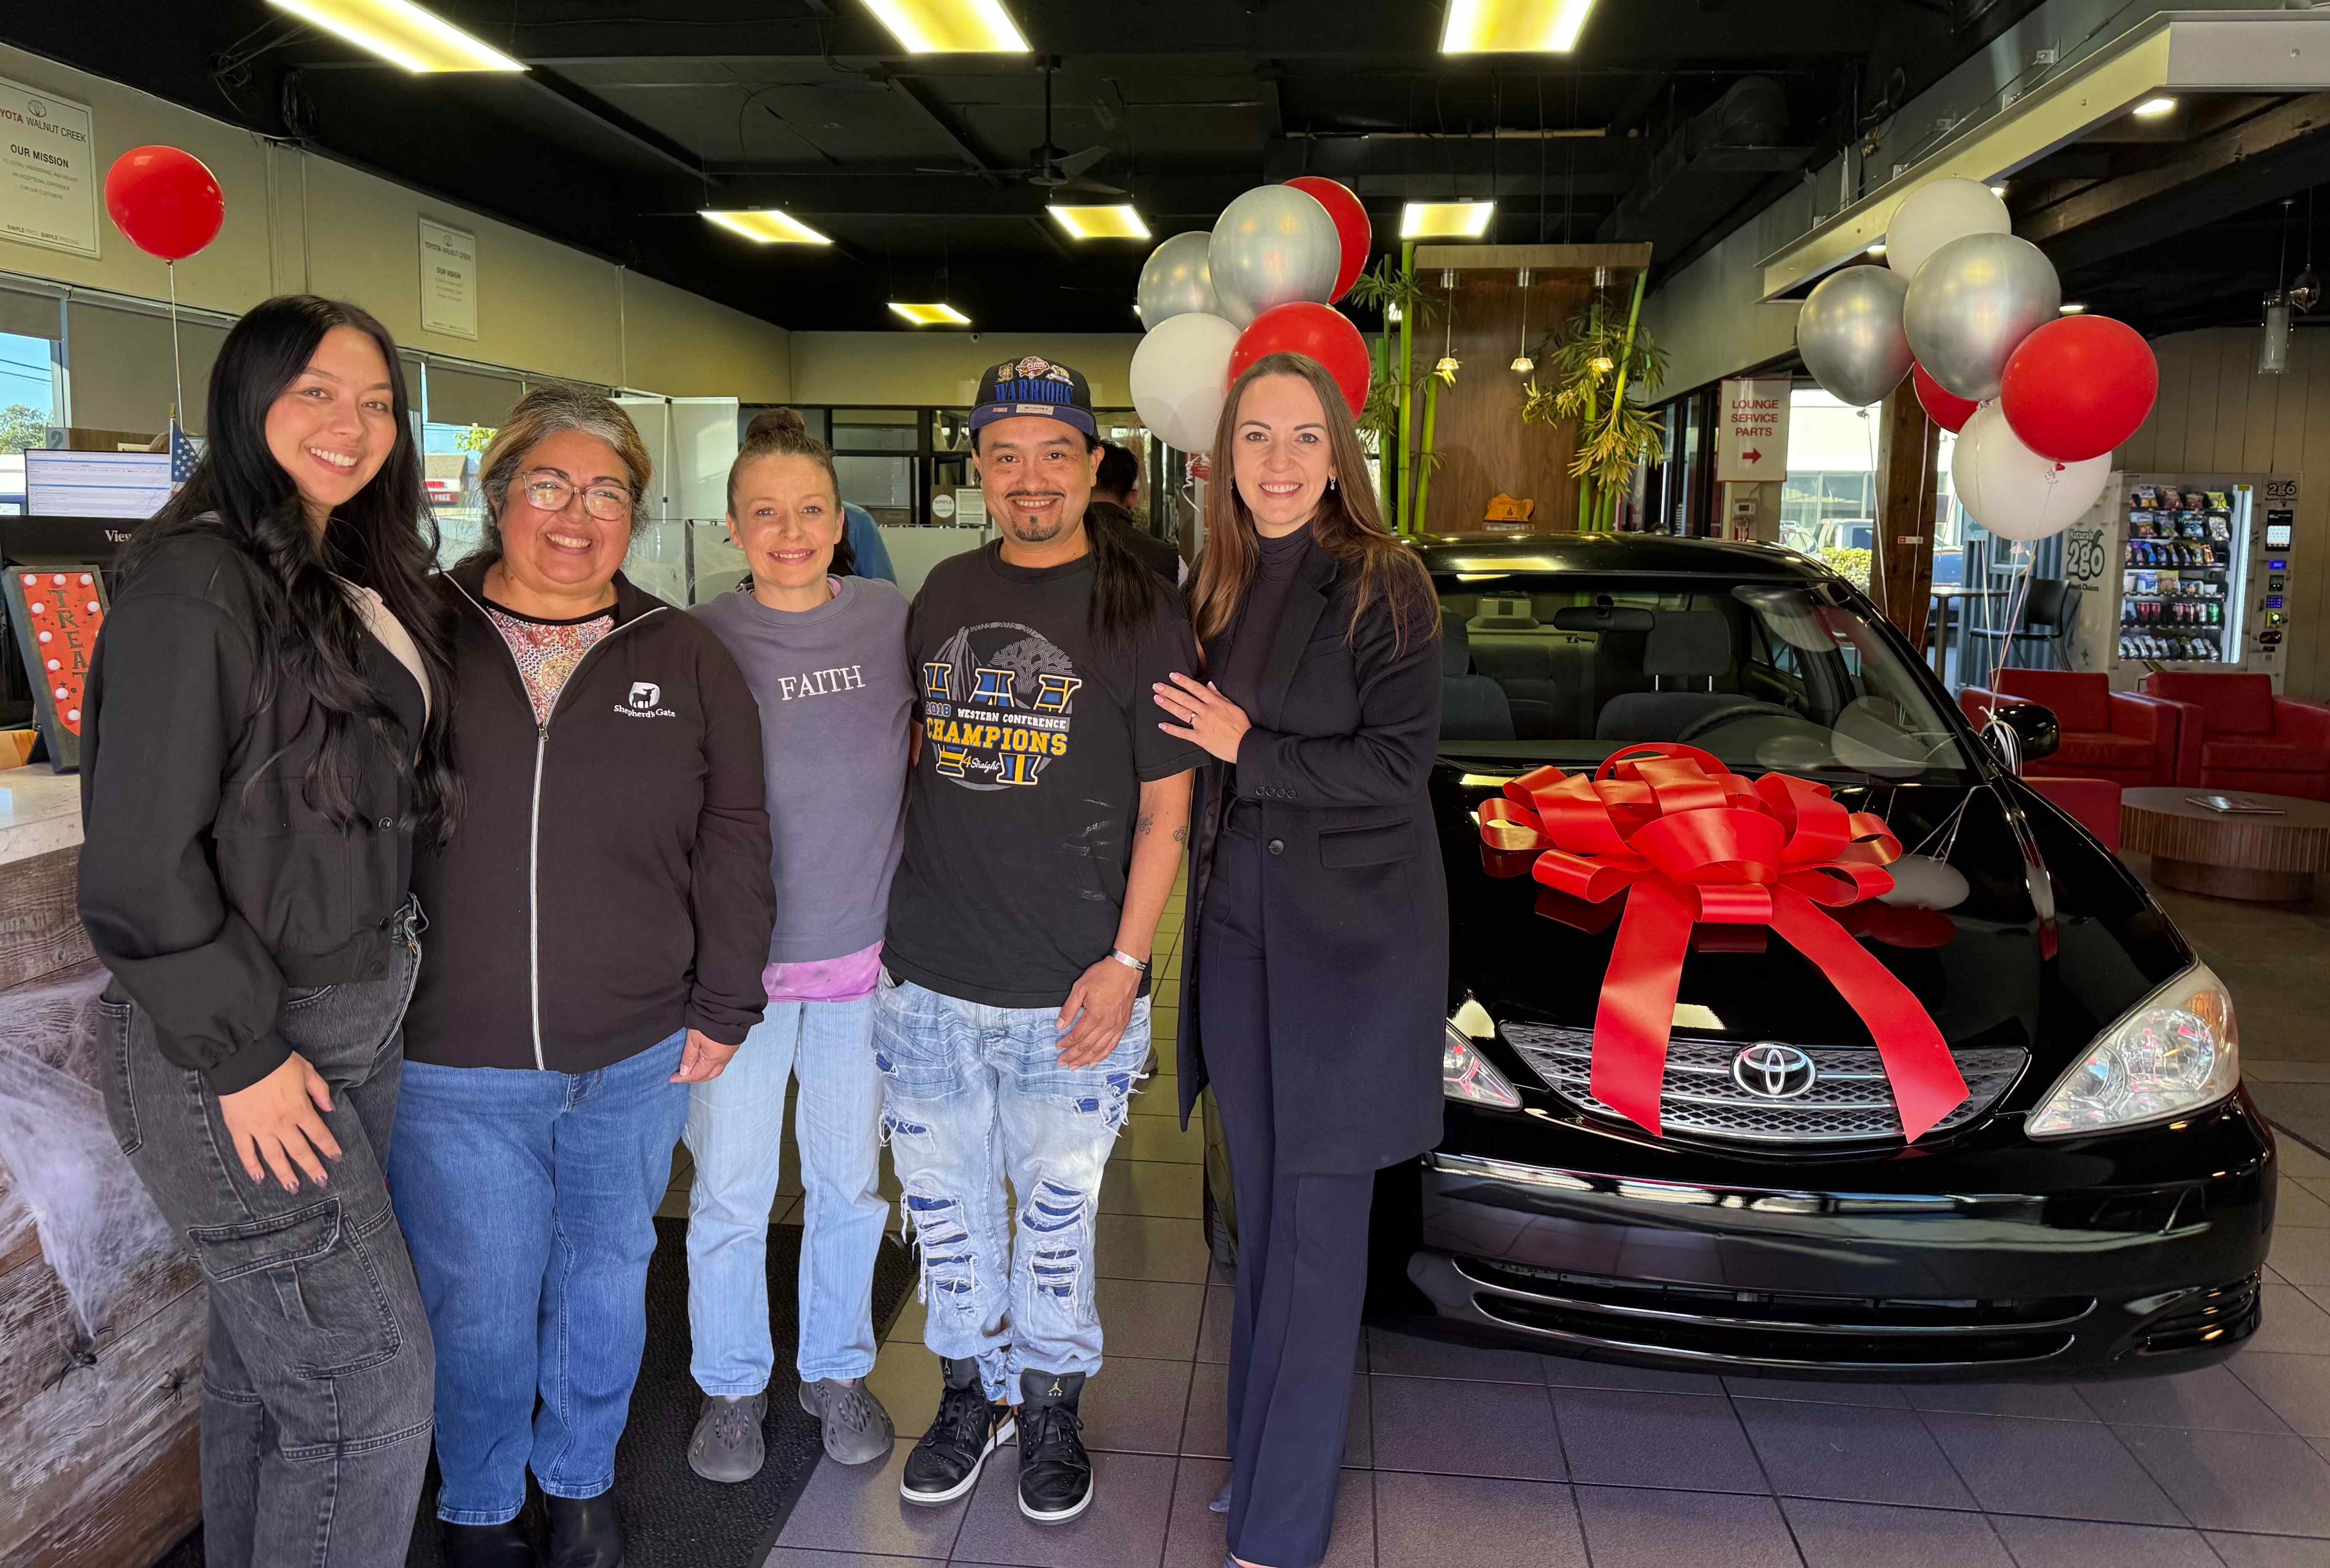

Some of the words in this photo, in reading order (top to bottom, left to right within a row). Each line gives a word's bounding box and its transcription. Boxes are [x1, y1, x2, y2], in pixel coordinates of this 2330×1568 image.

[26, 116, 59, 134] WALNUT
[61, 128, 87, 143] CREEK
[11, 144, 30, 157] OUR
[33, 150, 69, 168] MISSION
[994, 379, 1074, 405] WARRIORS
[1732, 399, 1779, 409] LOUNGE
[1731, 413, 1778, 422] SERVICE
[1735, 427, 1773, 437] PARTS
[47, 589, 90, 682] TREAT
[778, 665, 866, 701] FAITH
[614, 705, 655, 718] Shepherd's
[655, 708, 676, 717] Gate
[926, 701, 952, 717] 2018
[957, 708, 999, 722] WESTERN
[1002, 713, 1066, 729] CONFERENCE
[926, 717, 1067, 756] CHAMPIONS
[970, 757, 1001, 773] Straight
